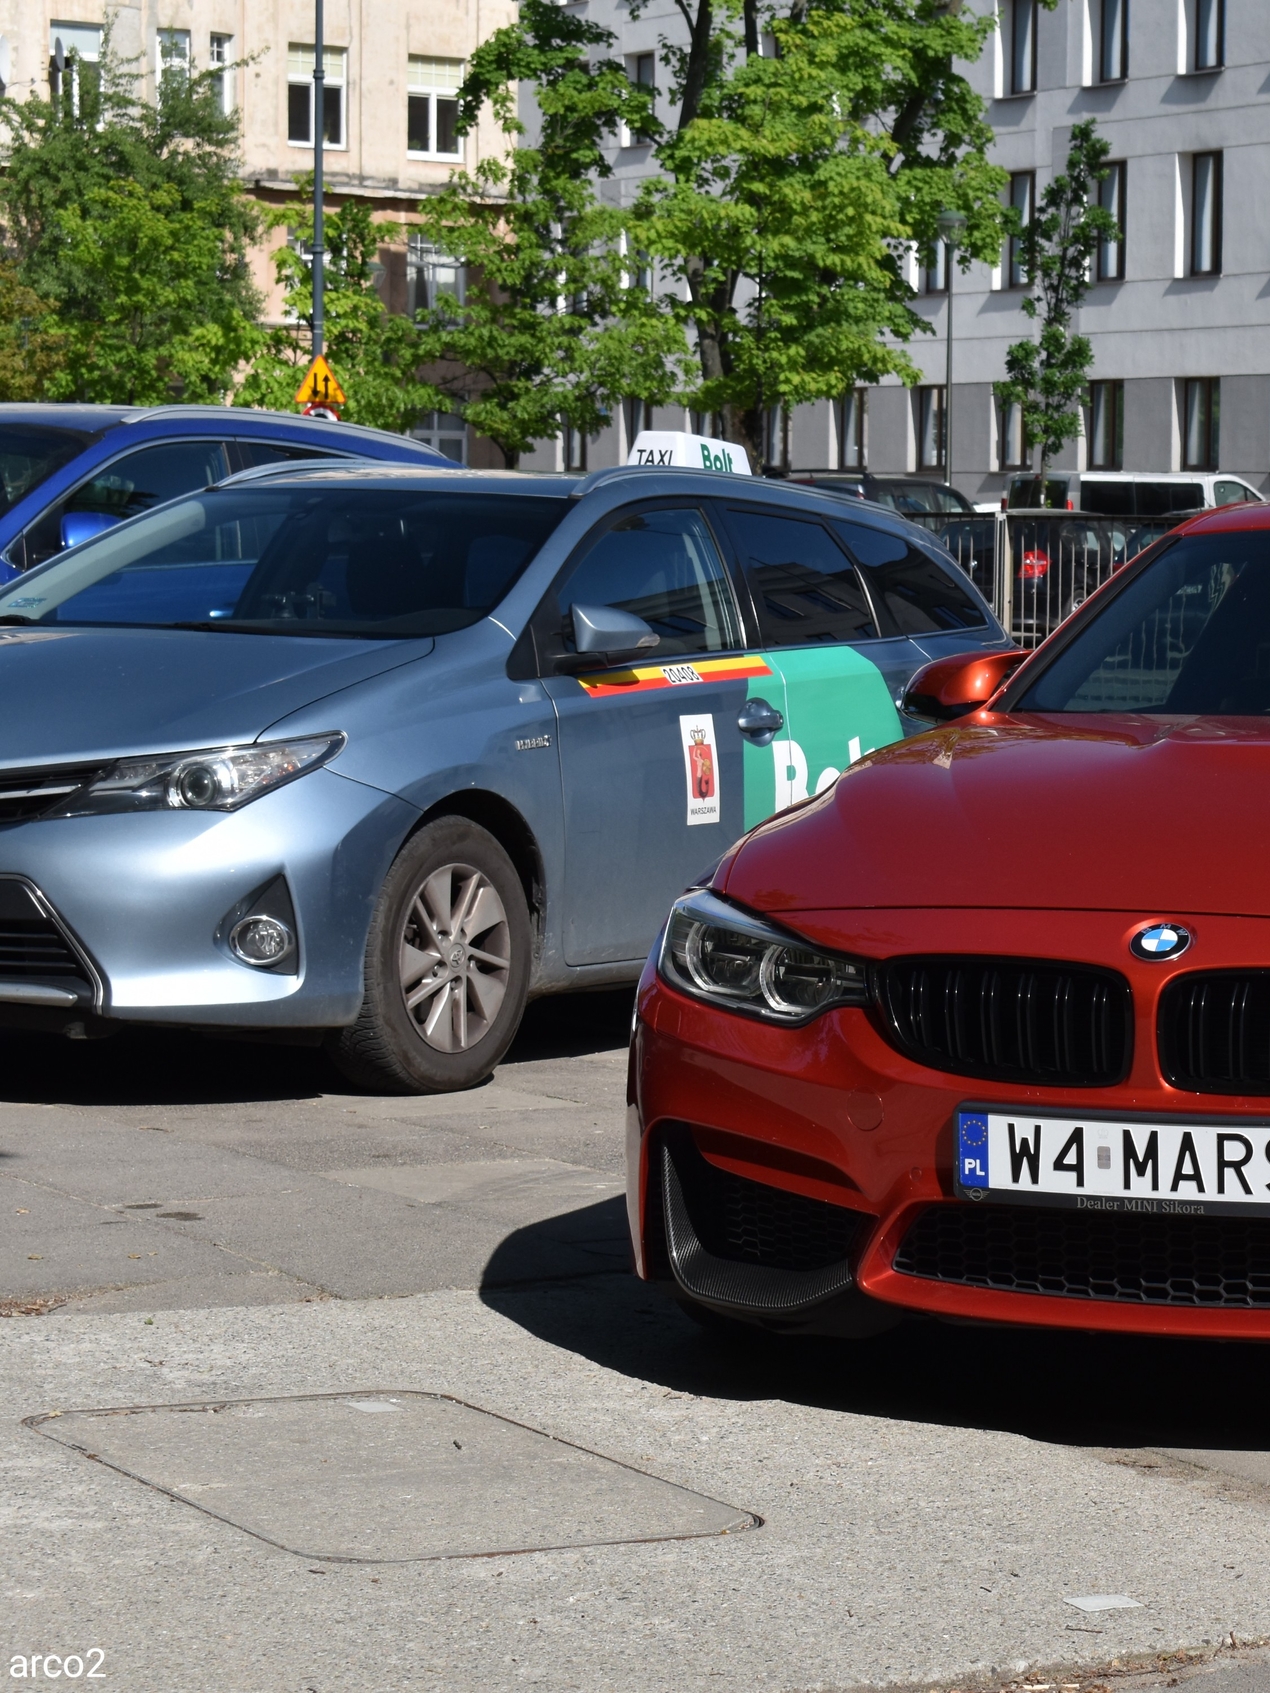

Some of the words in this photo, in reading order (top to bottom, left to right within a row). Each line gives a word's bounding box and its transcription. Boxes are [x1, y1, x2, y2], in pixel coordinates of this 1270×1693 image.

[637, 449, 674, 465] TAXI
[700, 443, 733, 472] Bolt
[662, 666, 700, 683] 20408
[690, 806, 717, 816] WARSZAWA
[1007, 1122, 1084, 1187] W4
[964, 1158, 985, 1176] PL
[1077, 1196, 1120, 1210] Dealer
[1124, 1199, 1158, 1213] MINI
[1161, 1201, 1205, 1214] Sikora
